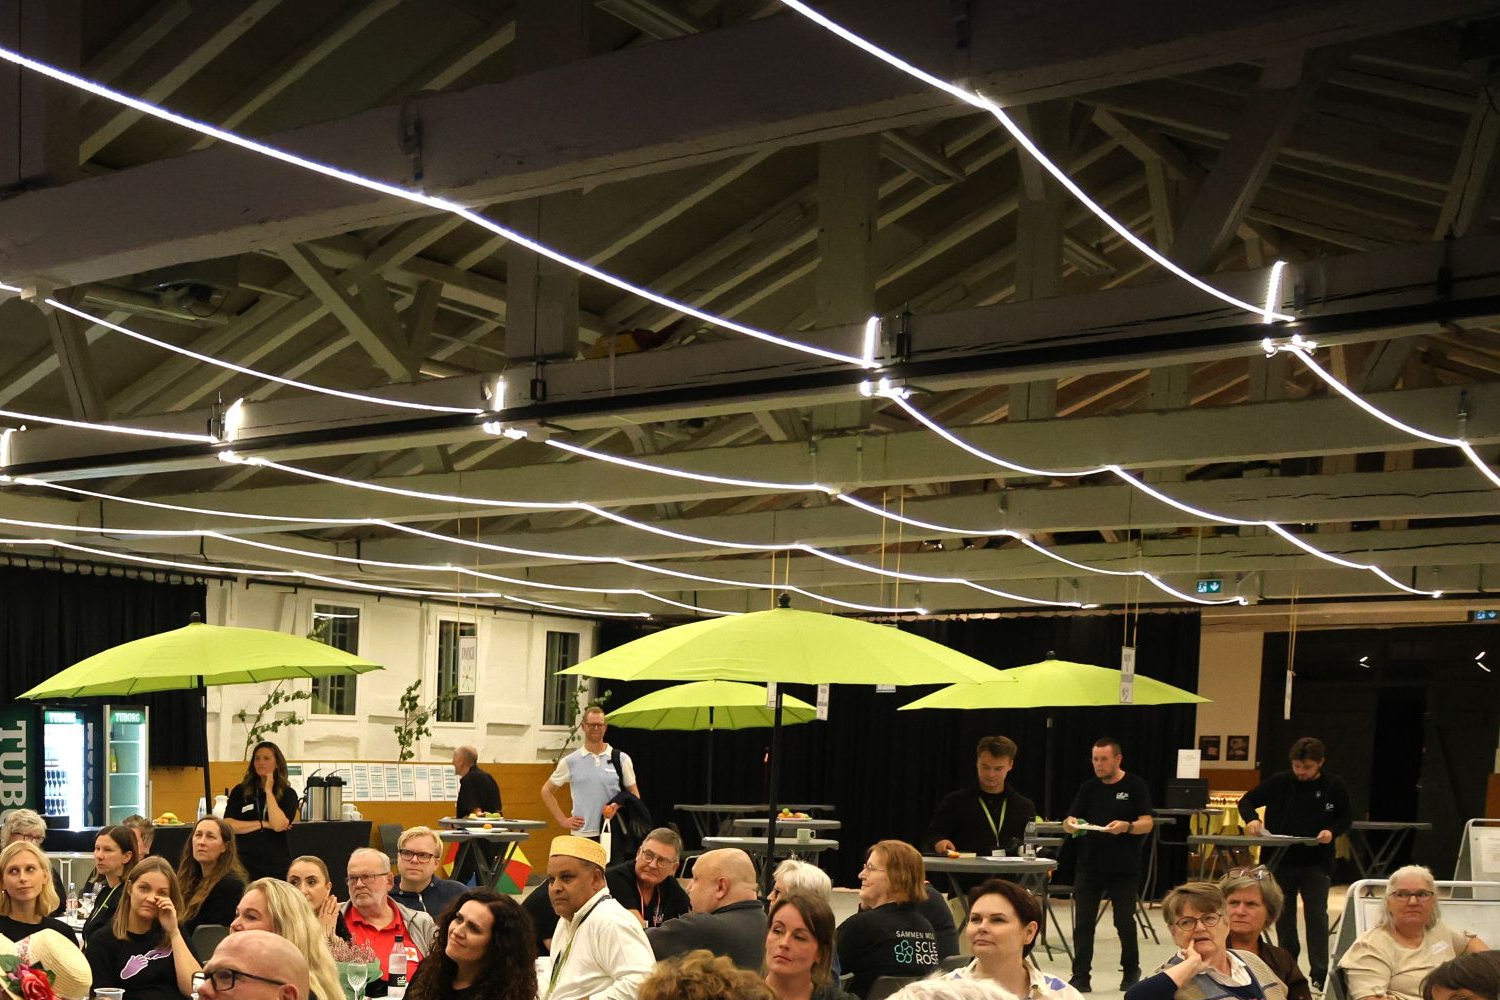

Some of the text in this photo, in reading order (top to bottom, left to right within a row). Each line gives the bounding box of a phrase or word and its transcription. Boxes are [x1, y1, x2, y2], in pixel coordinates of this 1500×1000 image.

[115, 712, 141, 722] TUBORG
[896, 930, 924, 939] SAMMEN
[915, 941, 938, 953] SCLE
